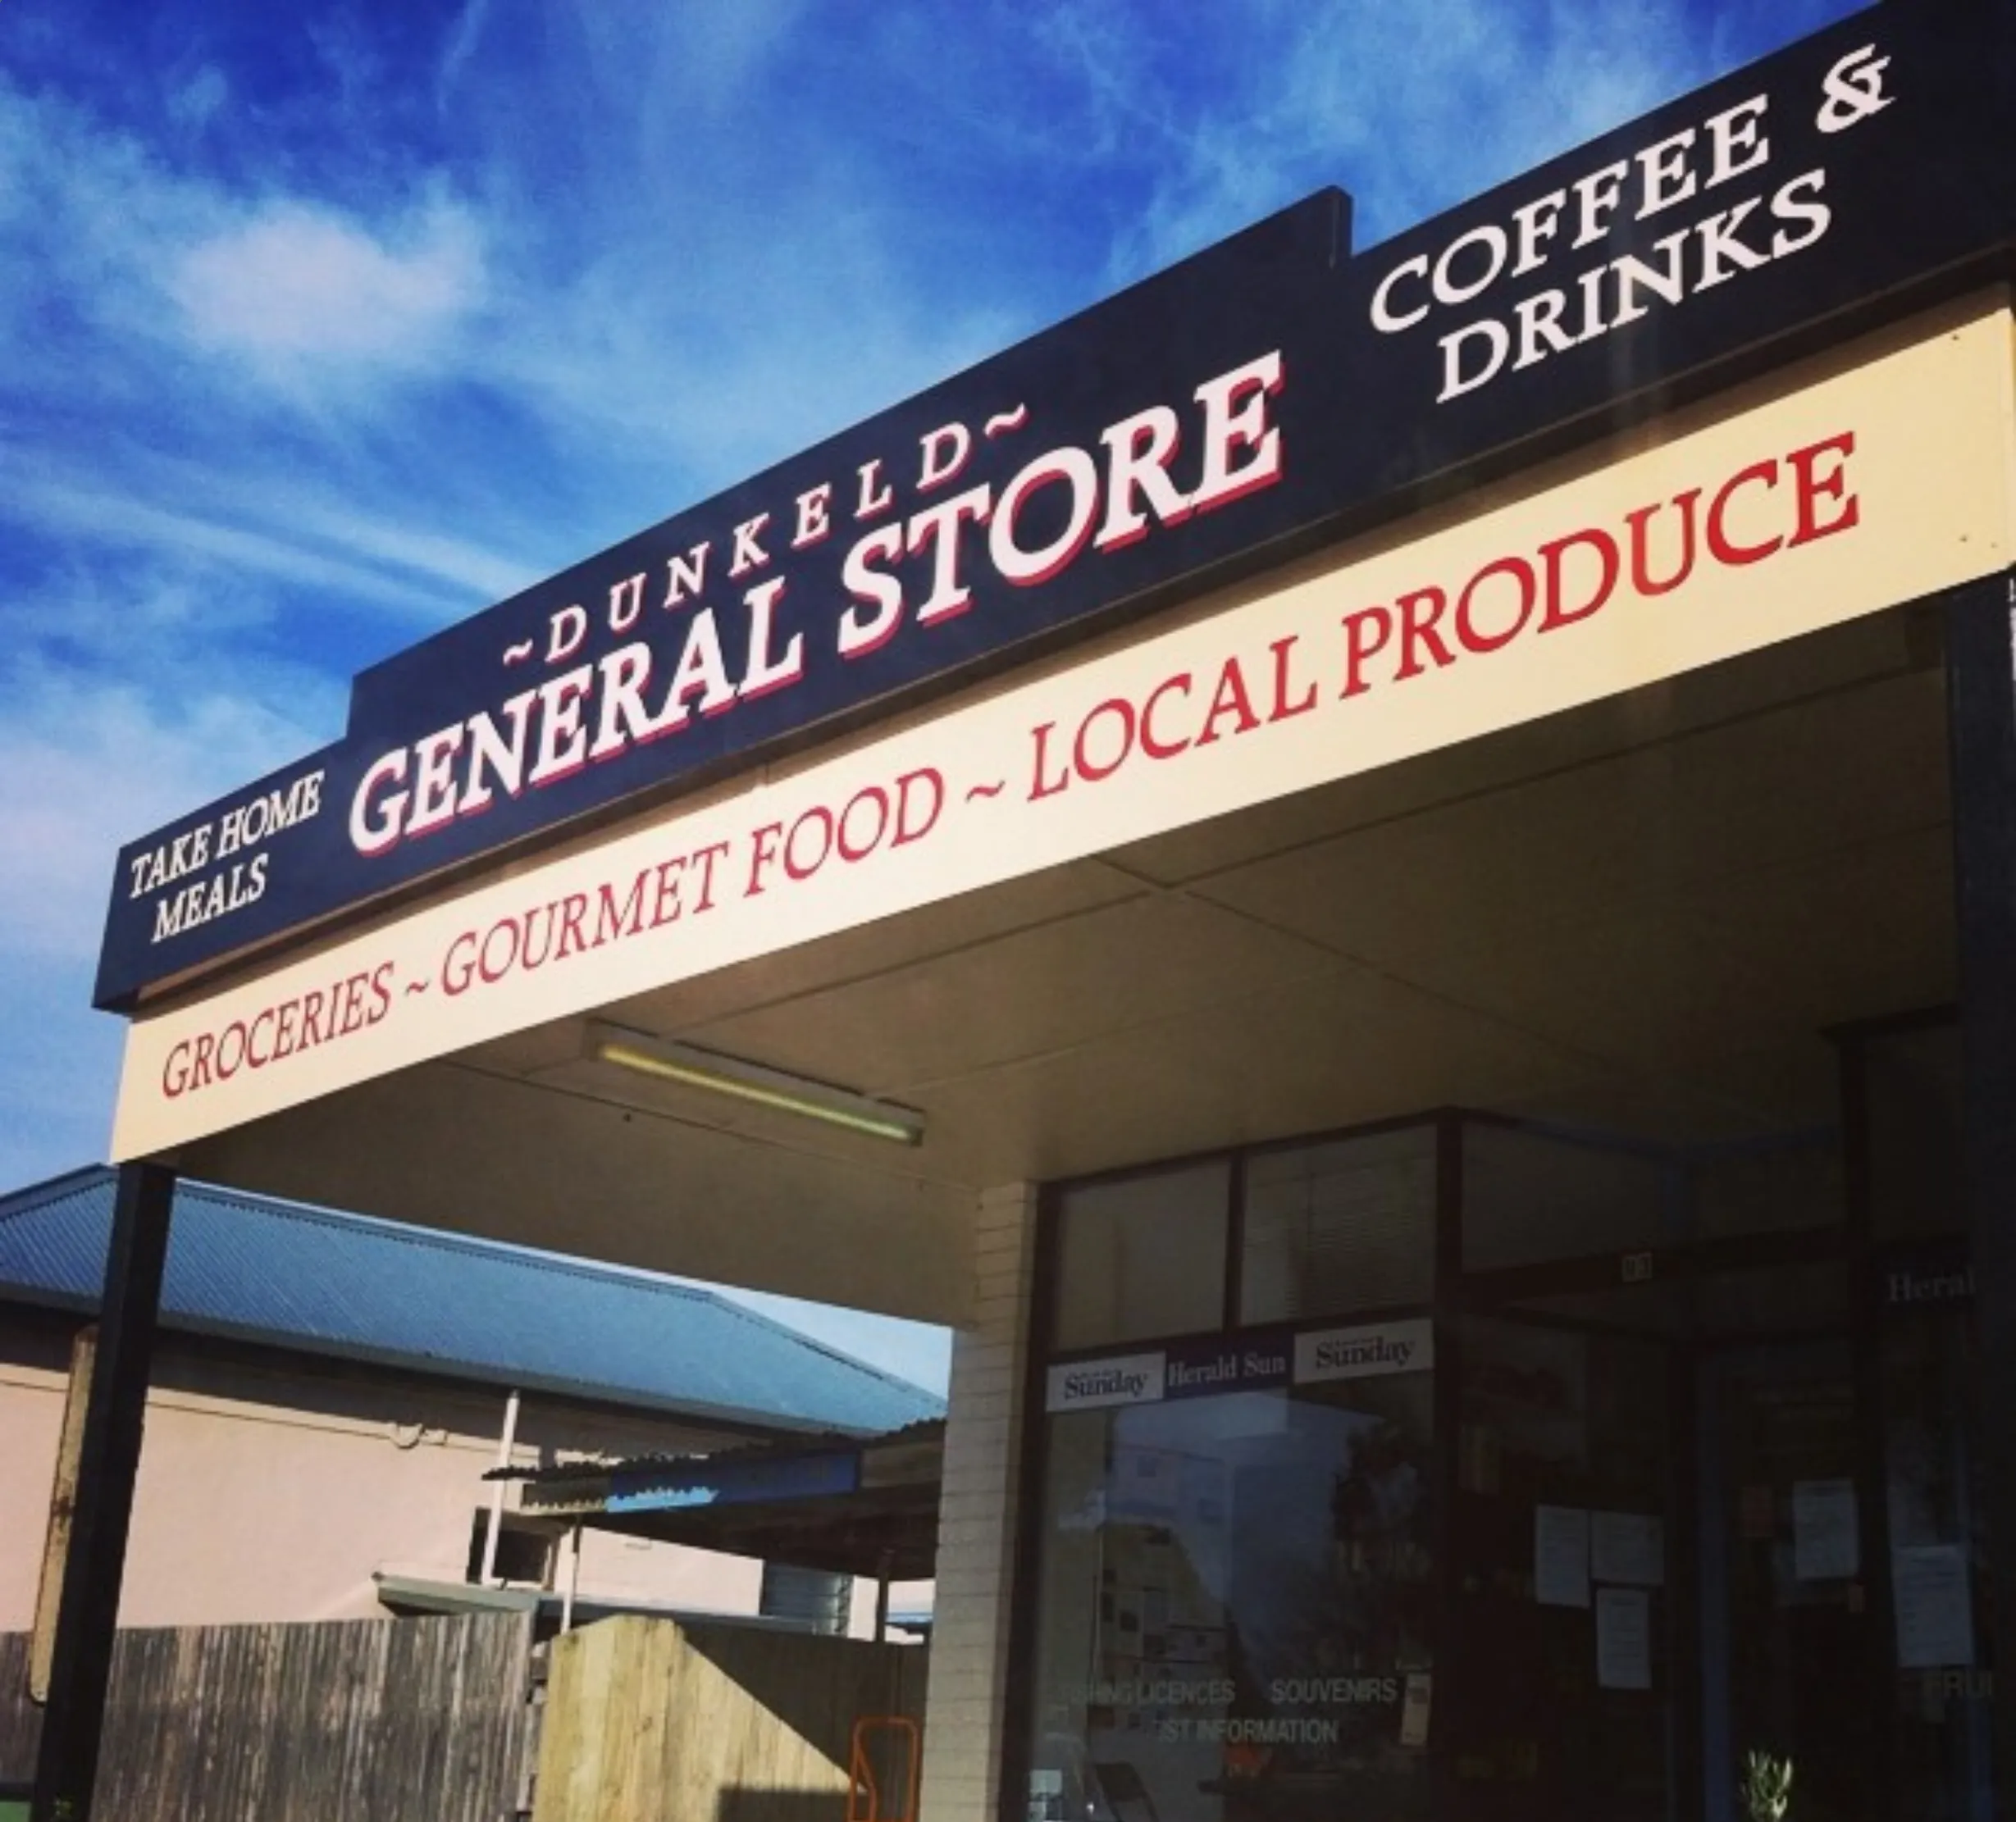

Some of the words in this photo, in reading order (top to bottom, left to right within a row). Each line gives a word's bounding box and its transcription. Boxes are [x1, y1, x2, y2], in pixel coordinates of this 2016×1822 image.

[1370, 93, 1771, 335] COFFEE
[1816, 42, 1898, 134] &
[1435, 167, 1832, 404] DRINKS
[348, 575, 805, 859] GENERAL
[837, 348, 1285, 658] STORE
[162, 960, 395, 1100] GROCERIES
[440, 840, 730, 997] GOURMET
[743, 767, 945, 900] FOOD
[1026, 634, 1319, 804] LOCAL
[1338, 430, 1859, 702] PRODUCE
[130, 823, 211, 900] TAKE
[216, 768, 326, 859] HOME
[150, 853, 270, 944] MEALS
[1064, 1369, 1148, 1401] Sunday
[1167, 1351, 1238, 1387] Herald
[1243, 1351, 1287, 1377] Sun
[1315, 1336, 1416, 1369] Sunday
[1136, 1678, 1237, 1706] LICENCES
[1270, 1677, 1398, 1705] SOUVENIRS
[1197, 1717, 1339, 1745] INFORMATION
